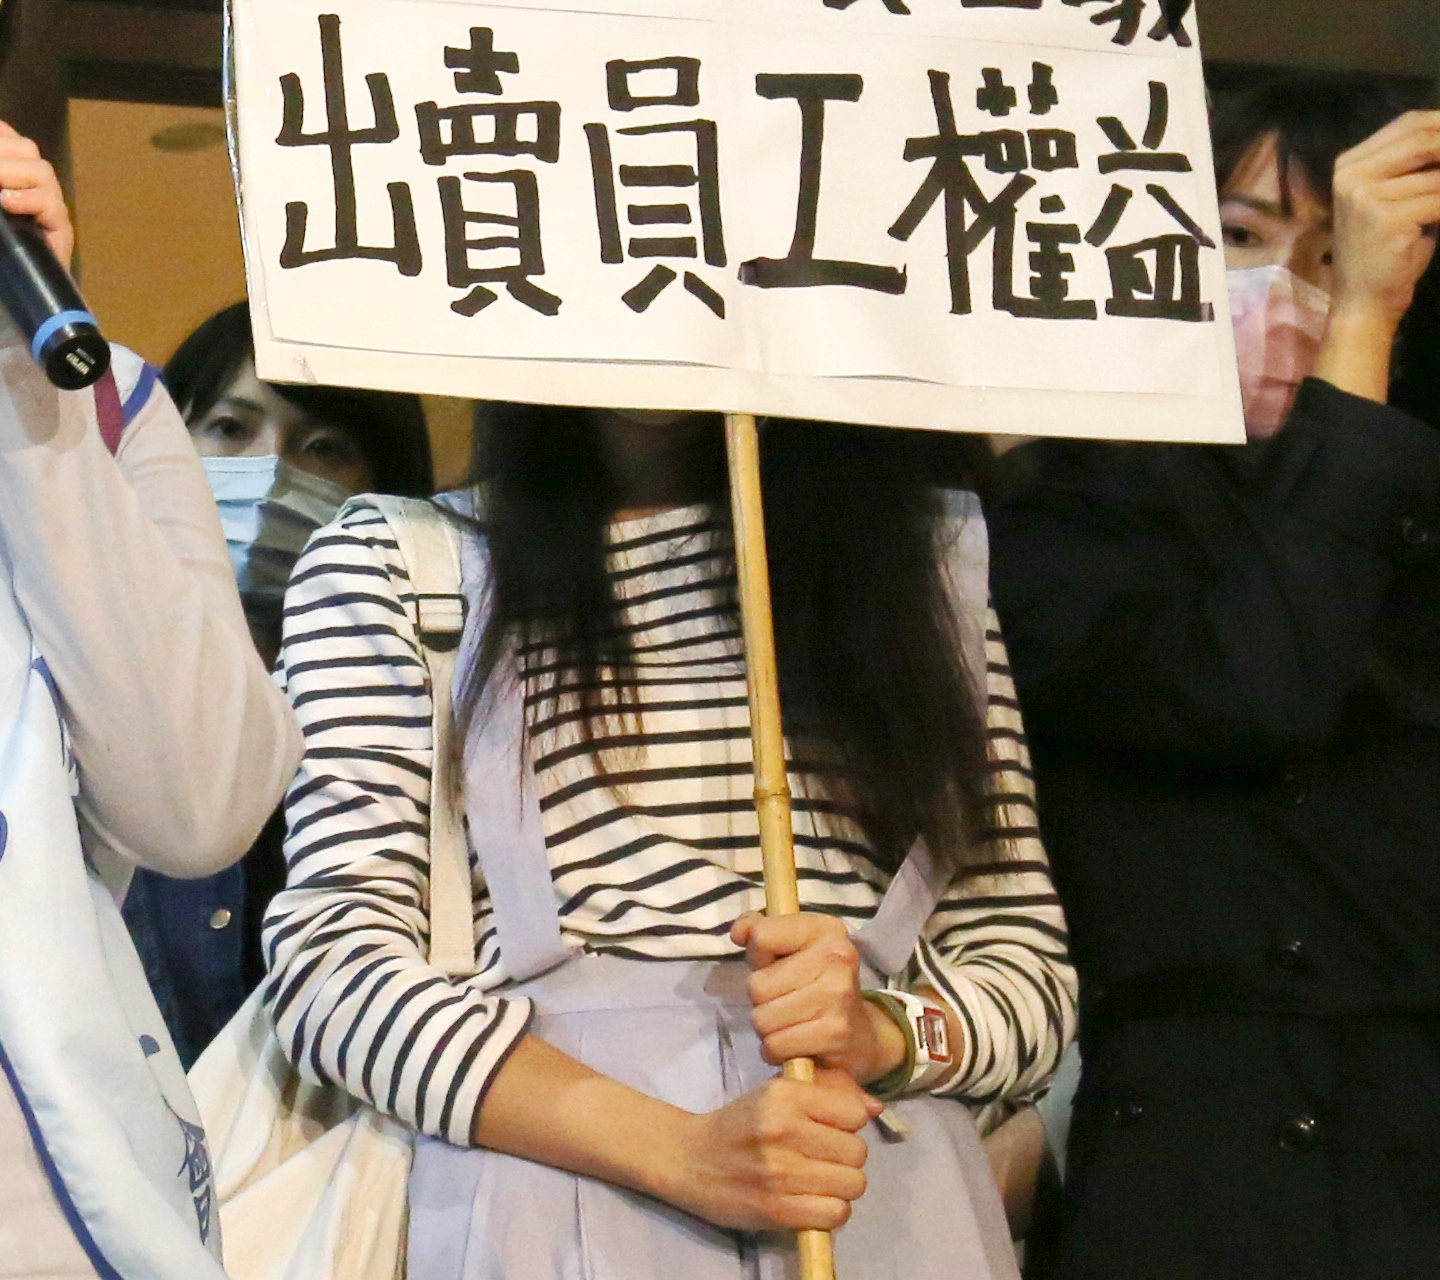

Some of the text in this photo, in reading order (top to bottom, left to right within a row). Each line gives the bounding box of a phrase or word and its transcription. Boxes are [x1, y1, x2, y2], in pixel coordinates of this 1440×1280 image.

[275, 13, 1214, 322] 出賣員工權益
